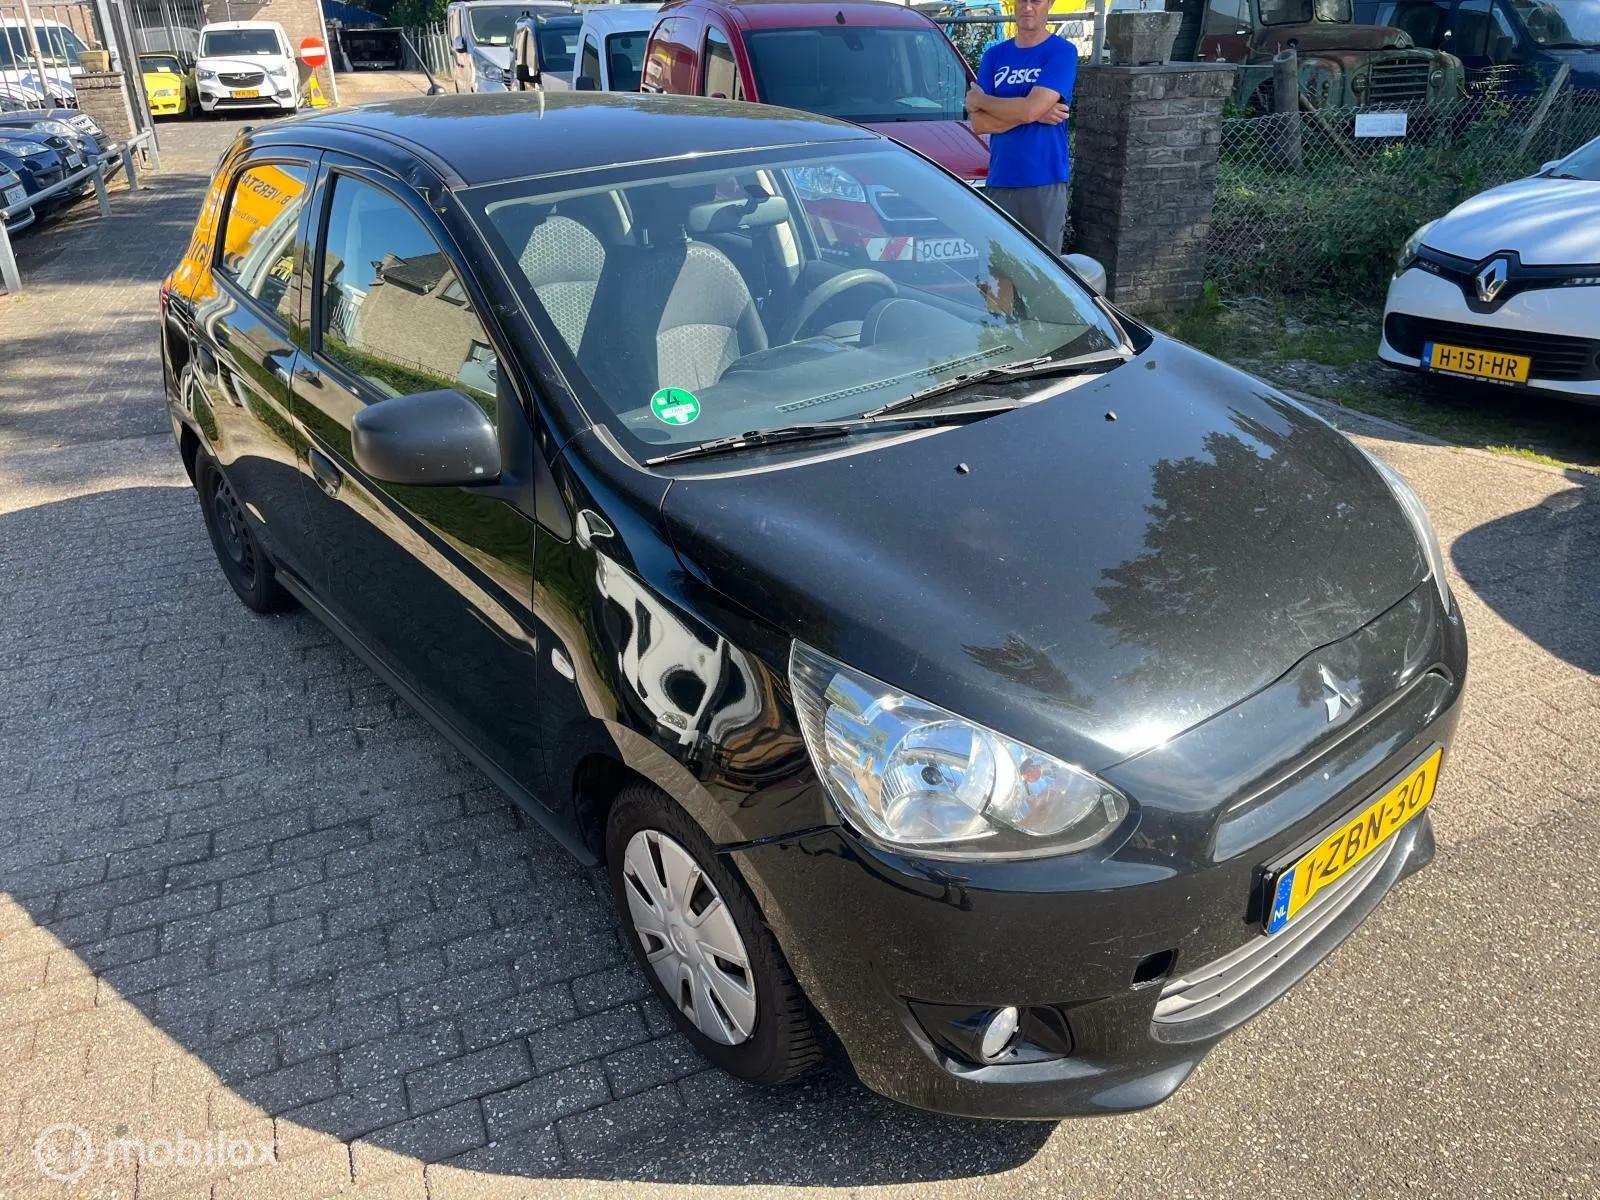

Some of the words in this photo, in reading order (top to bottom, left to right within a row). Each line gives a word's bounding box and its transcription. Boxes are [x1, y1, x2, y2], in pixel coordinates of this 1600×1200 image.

[1439, 347, 1518, 377] H-151-HR
[1304, 770, 1426, 895] 1-ZBN-30
[1273, 903, 1287, 923] NL
